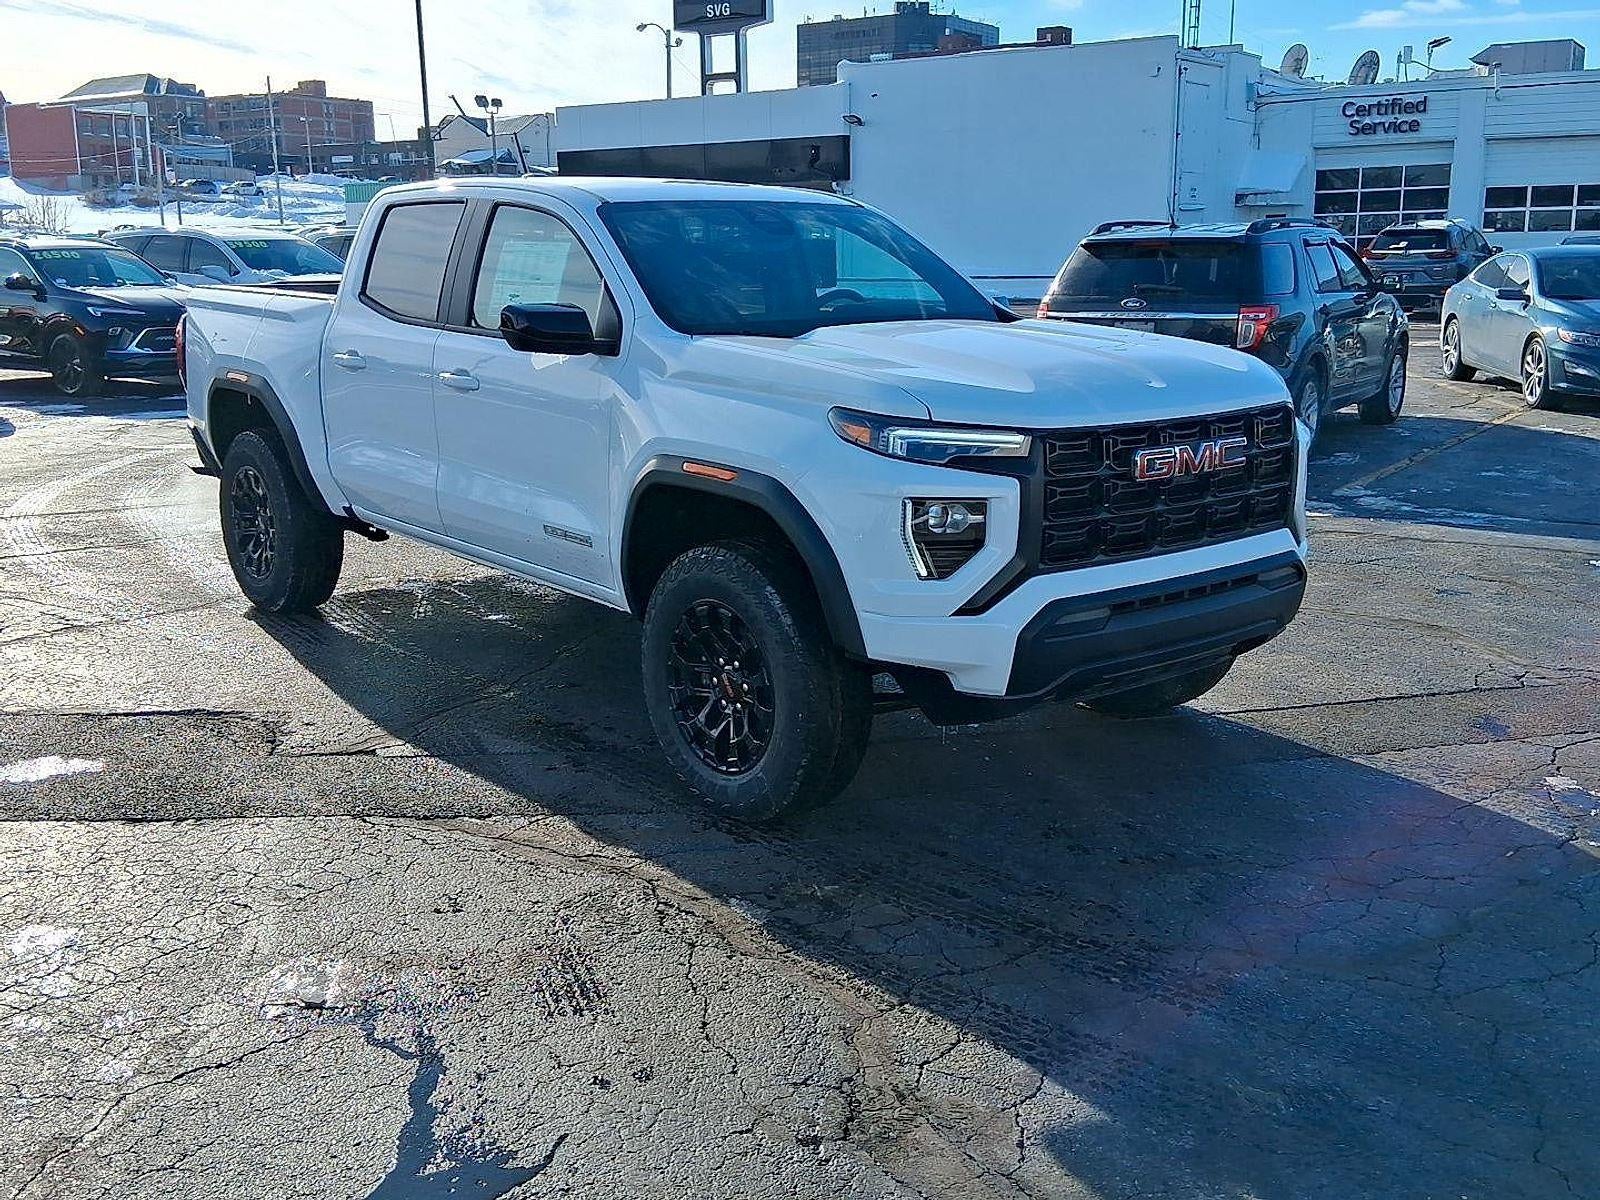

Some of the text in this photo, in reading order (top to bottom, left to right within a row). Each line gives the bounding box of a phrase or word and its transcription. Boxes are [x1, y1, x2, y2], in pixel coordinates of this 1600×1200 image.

[706, 3, 730, 17] SVG
[1342, 96, 1428, 117] Certified
[1349, 117, 1420, 135] Service
[1135, 437, 1247, 481] GMC
